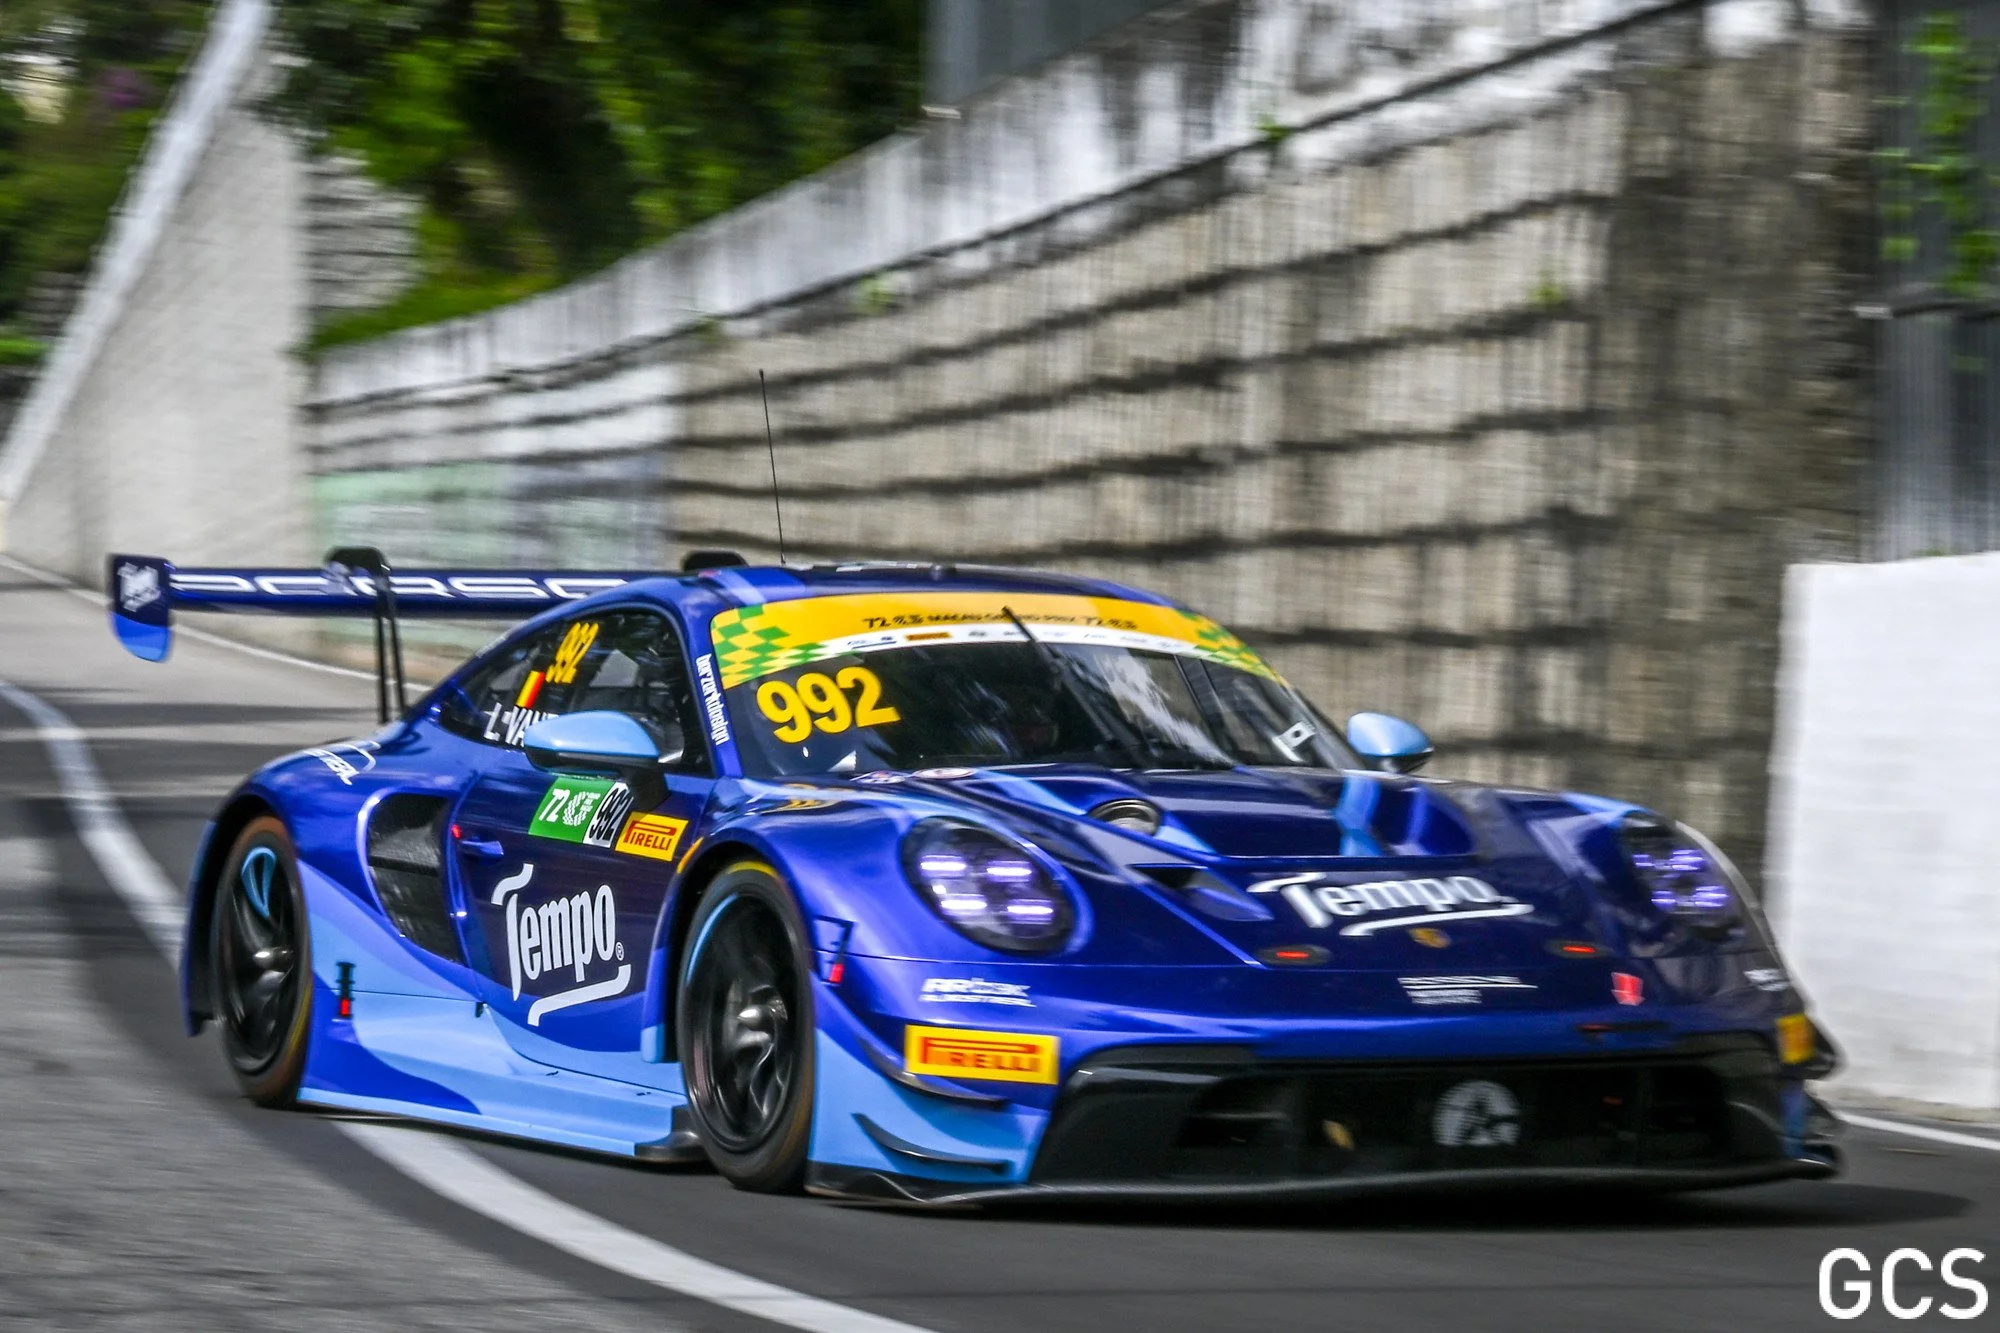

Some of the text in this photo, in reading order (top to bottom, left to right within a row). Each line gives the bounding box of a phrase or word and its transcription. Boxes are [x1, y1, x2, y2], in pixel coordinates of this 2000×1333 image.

[545, 622, 599, 684] 992
[756, 666, 901, 744] 992
[538, 788, 572, 823] 72
[623, 820, 678, 851] PIRELLI
[1246, 871, 1502, 928] Tempo
[919, 1036, 1042, 1073] PIRELLI
